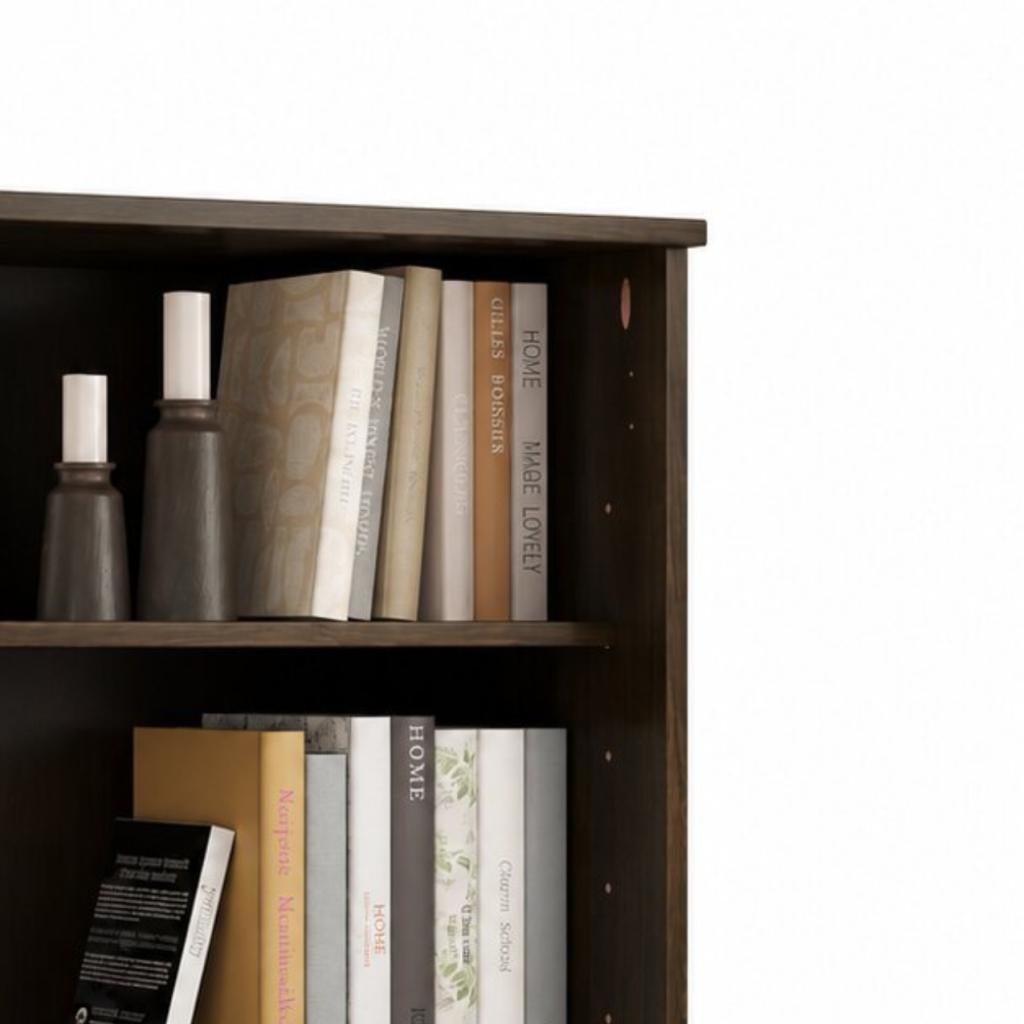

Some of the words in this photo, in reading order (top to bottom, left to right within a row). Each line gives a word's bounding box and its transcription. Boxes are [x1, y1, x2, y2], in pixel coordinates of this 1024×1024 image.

[522, 330, 542, 388] HOME
[522, 506, 542, 574] LOVELY
[409, 725, 425, 801] HOME
